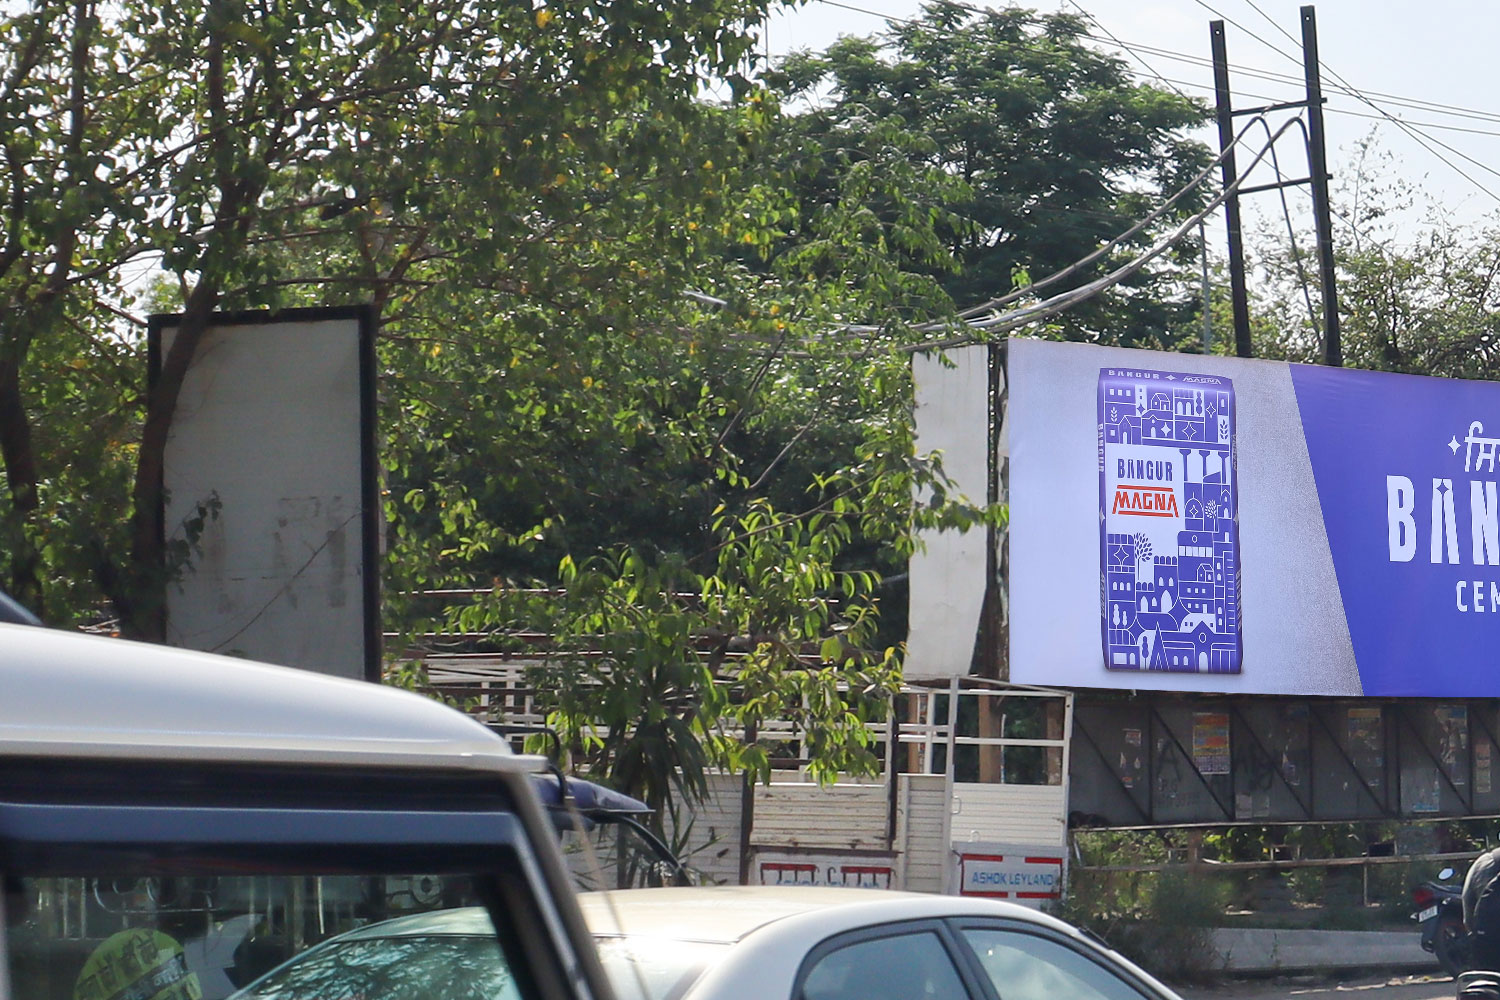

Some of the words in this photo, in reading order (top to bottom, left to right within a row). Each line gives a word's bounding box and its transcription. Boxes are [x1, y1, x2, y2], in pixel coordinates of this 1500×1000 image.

[1108, 369, 1160, 380] BANGUR
[1183, 375, 1221, 385] MAGNA
[1117, 458, 1173, 482] BANGUR
[1112, 489, 1179, 518] MAGNA
[971, 872, 1007, 885] ASHOK
[1009, 873, 1054, 886] LEYLAND
